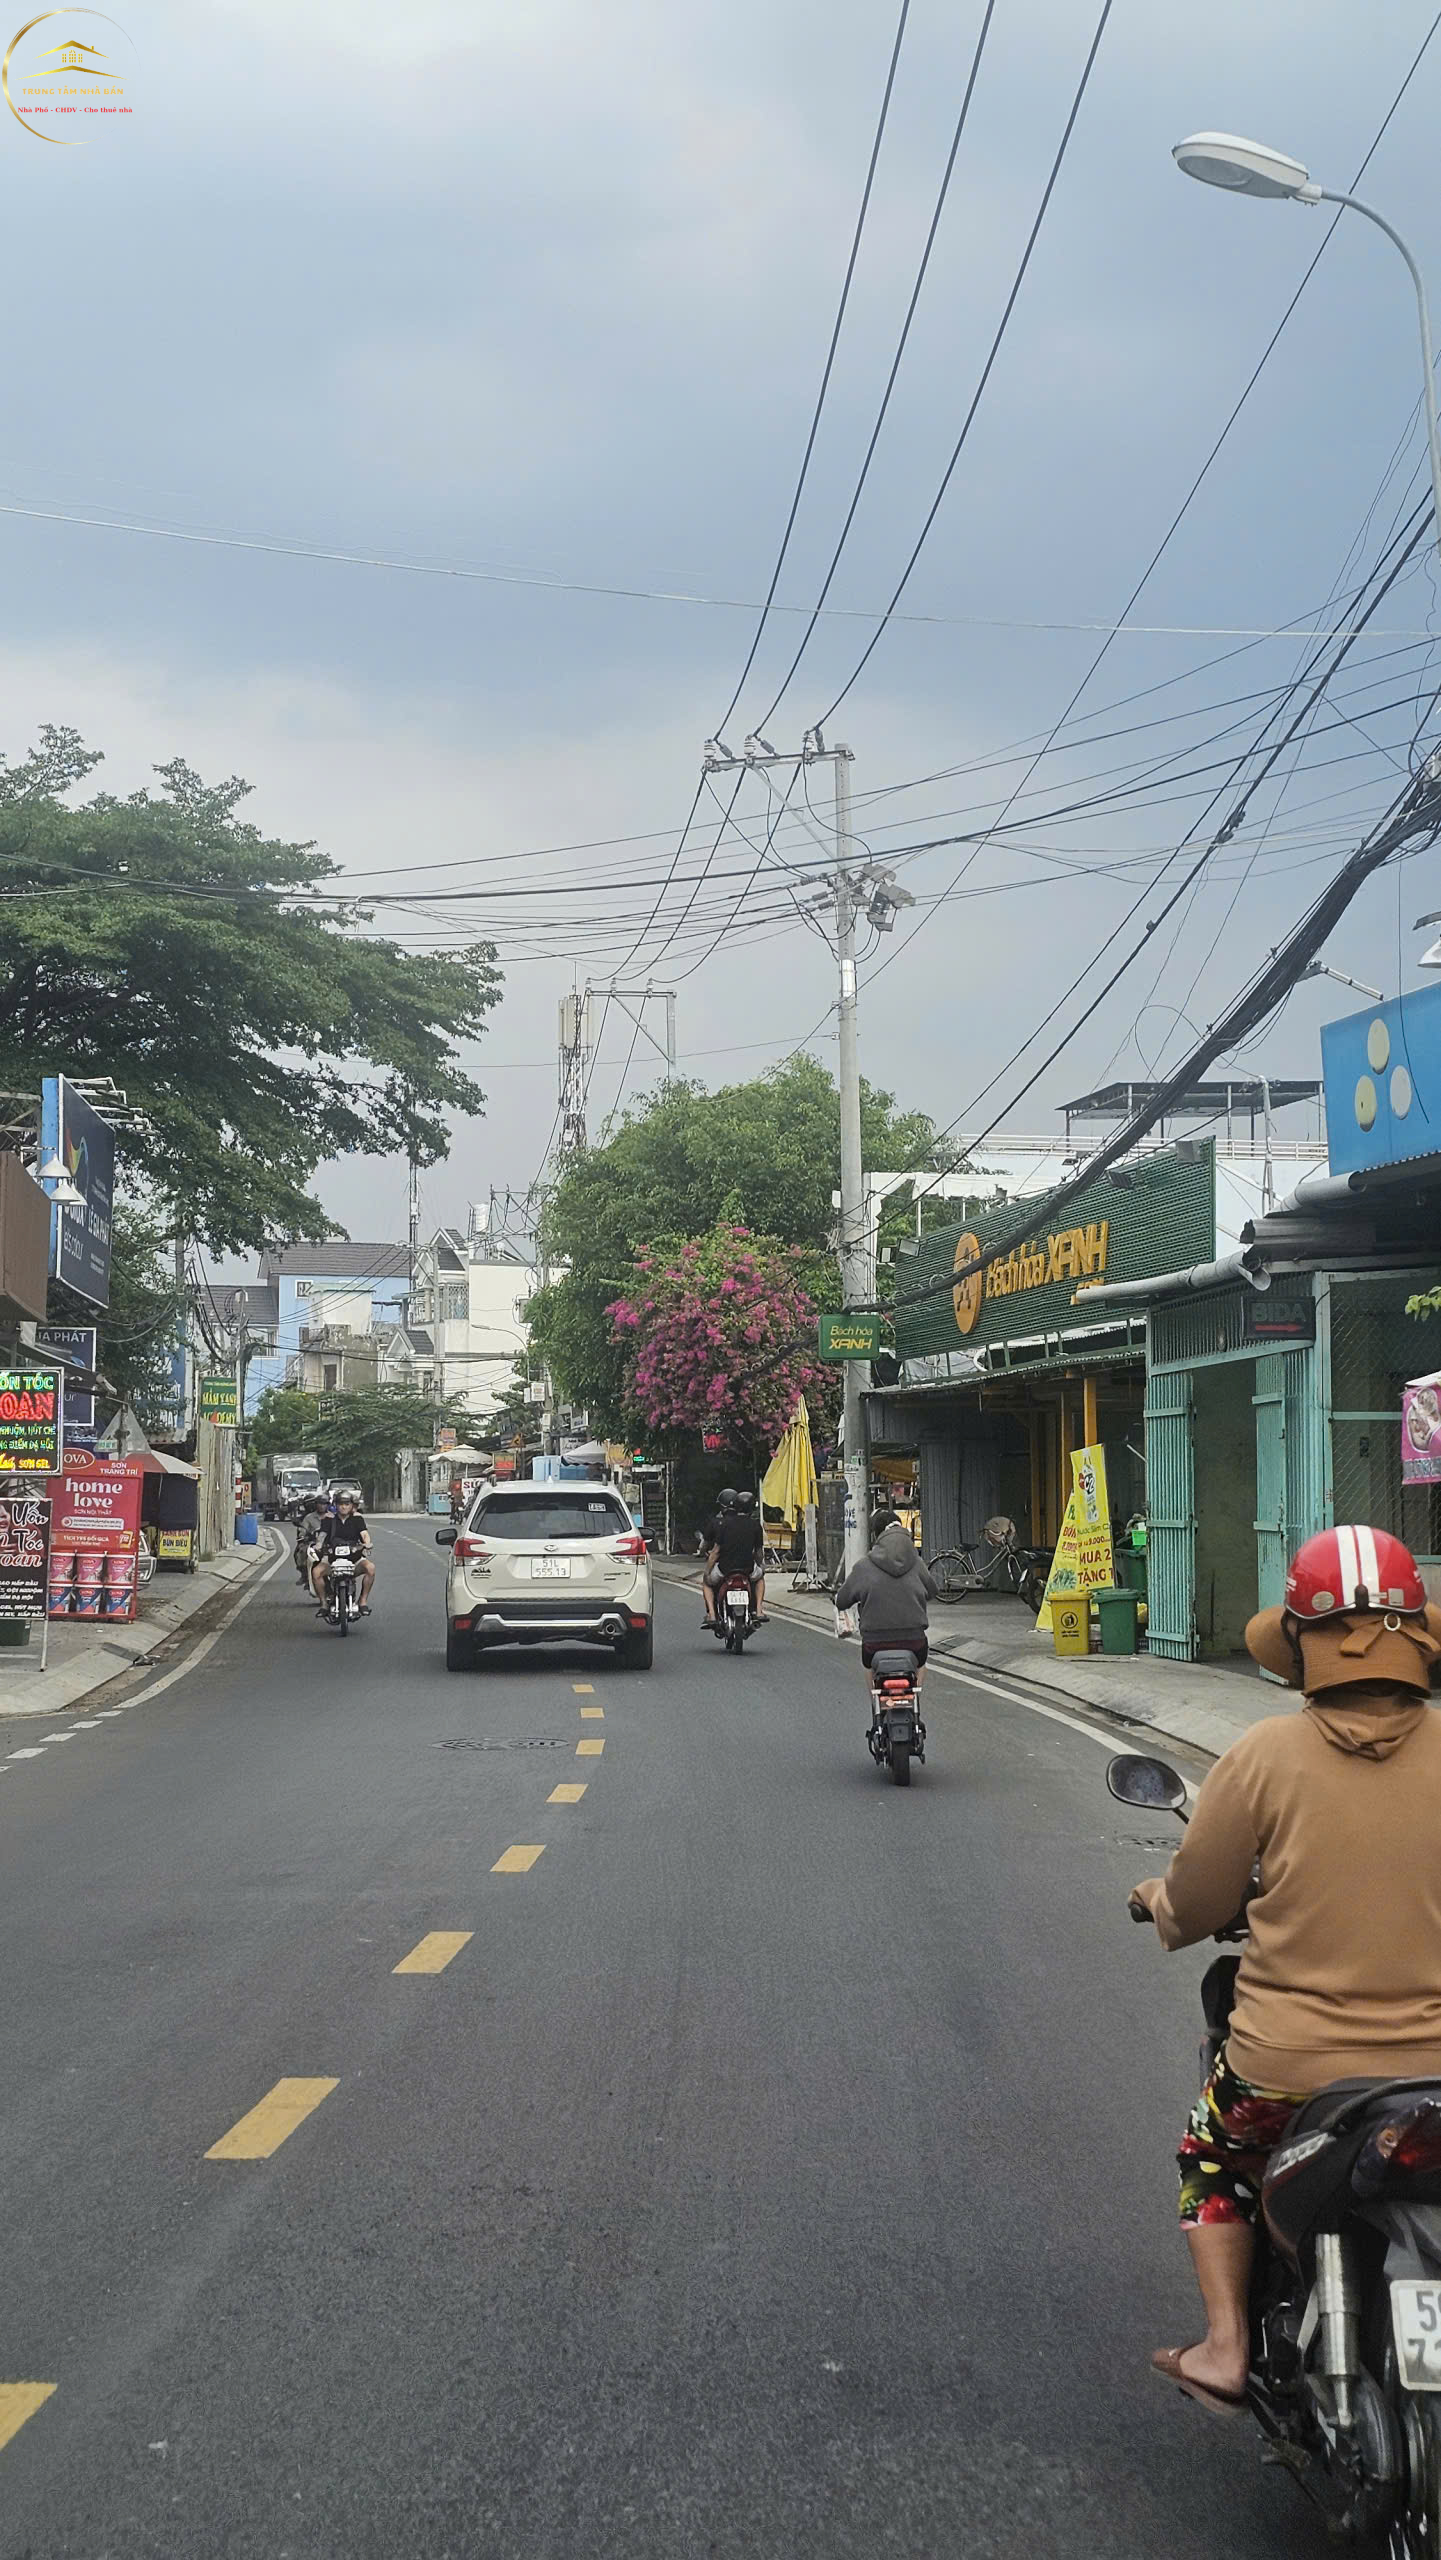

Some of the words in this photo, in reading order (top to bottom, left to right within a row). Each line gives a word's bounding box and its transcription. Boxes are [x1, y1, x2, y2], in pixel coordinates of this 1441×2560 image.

[1044, 1219, 1109, 1284] XANH
[54, 1329, 87, 1343] PHÁT
[828, 1338, 873, 1350] XANH
[22, 1371, 54, 1391] TÓC
[111, 1461, 127, 1469] SƠN
[126, 1467, 138, 1476] TRÍ
[65, 1477, 123, 1494] home
[73, 1492, 113, 1508] love
[11, 1501, 49, 1527] Uốn
[12, 1528, 44, 1553] Tóc
[542, 1559, 560, 1568] 51L
[1079, 1550, 1102, 1565] MUA
[1104, 1548, 1112, 1561] 2
[535, 1568, 567, 1577] 555.13
[1077, 1568, 1106, 1587] TẶNG
